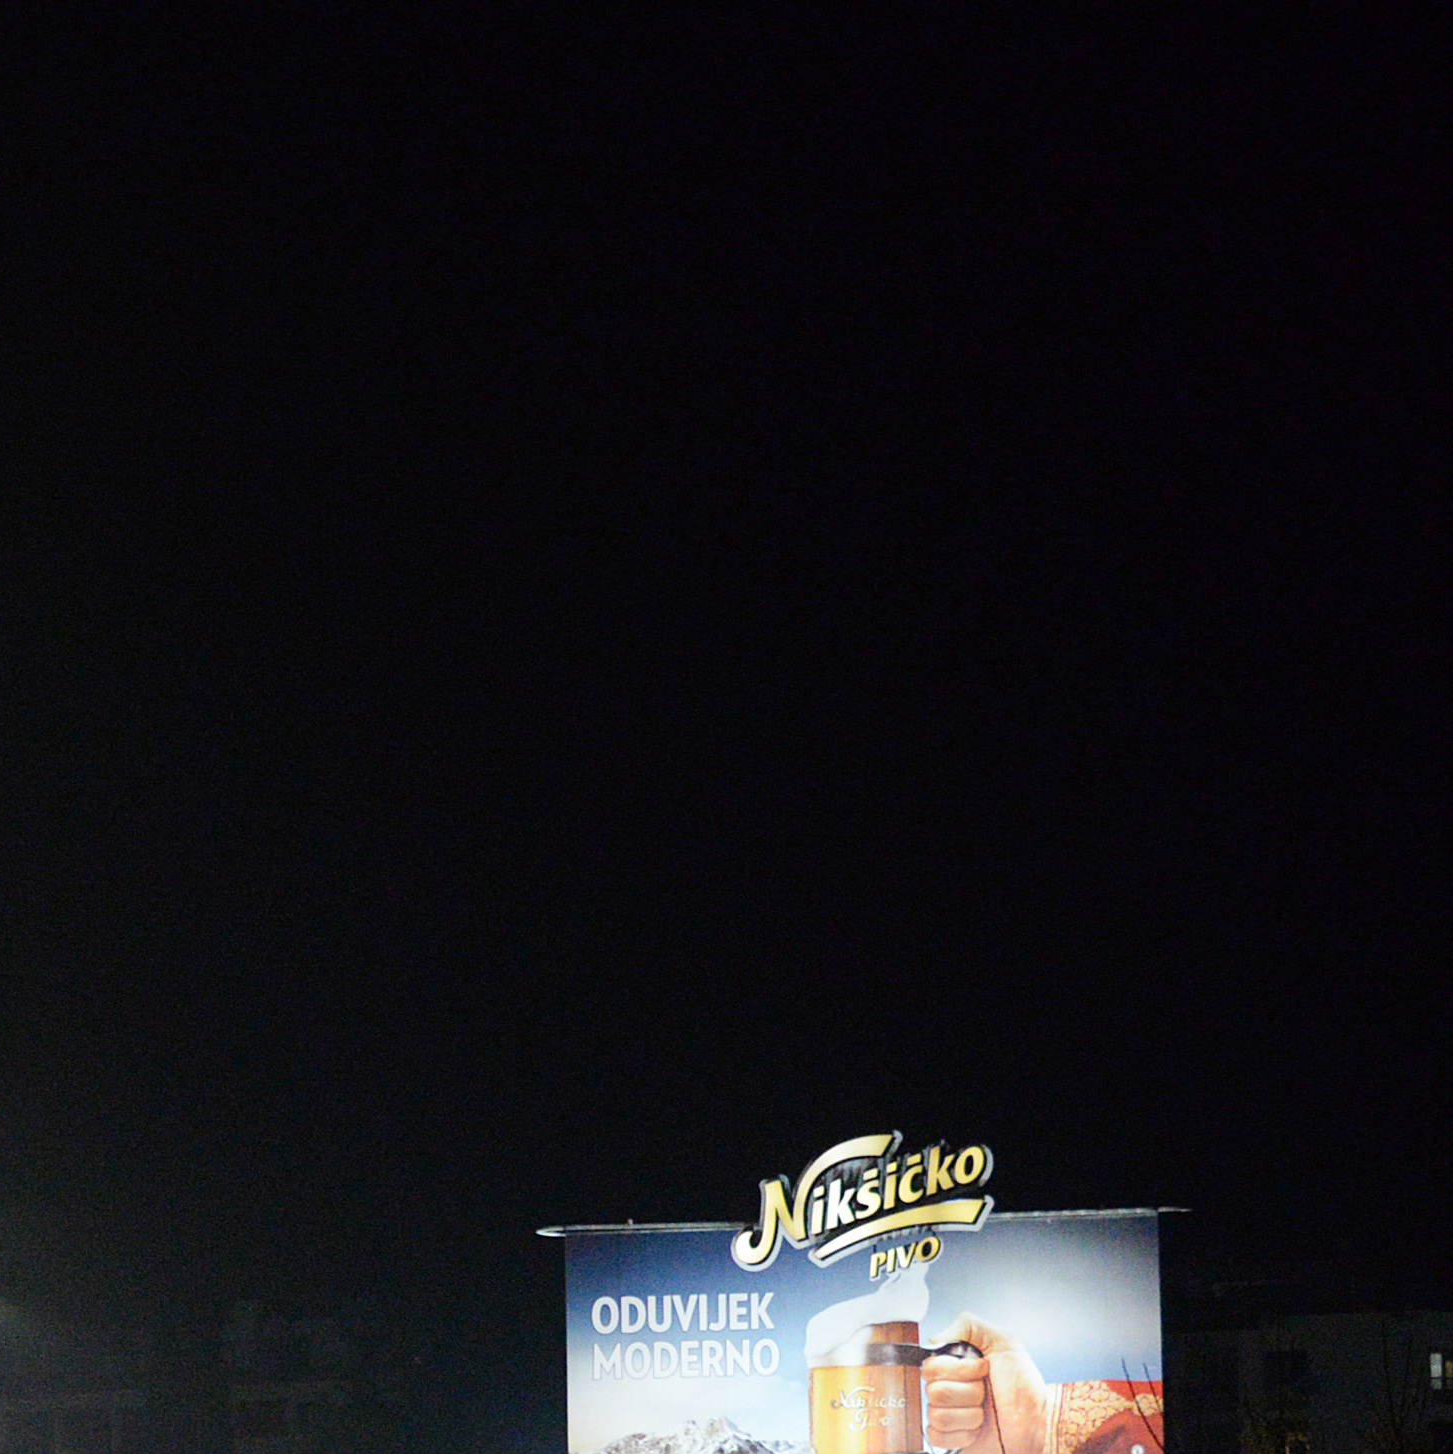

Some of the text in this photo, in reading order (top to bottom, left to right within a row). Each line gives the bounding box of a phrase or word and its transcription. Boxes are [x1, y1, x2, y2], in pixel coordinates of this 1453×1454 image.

[869, 1236, 941, 1279] PIVO
[591, 1292, 776, 1335] ODUVIJEK
[592, 1337, 781, 1381] MODERNO
